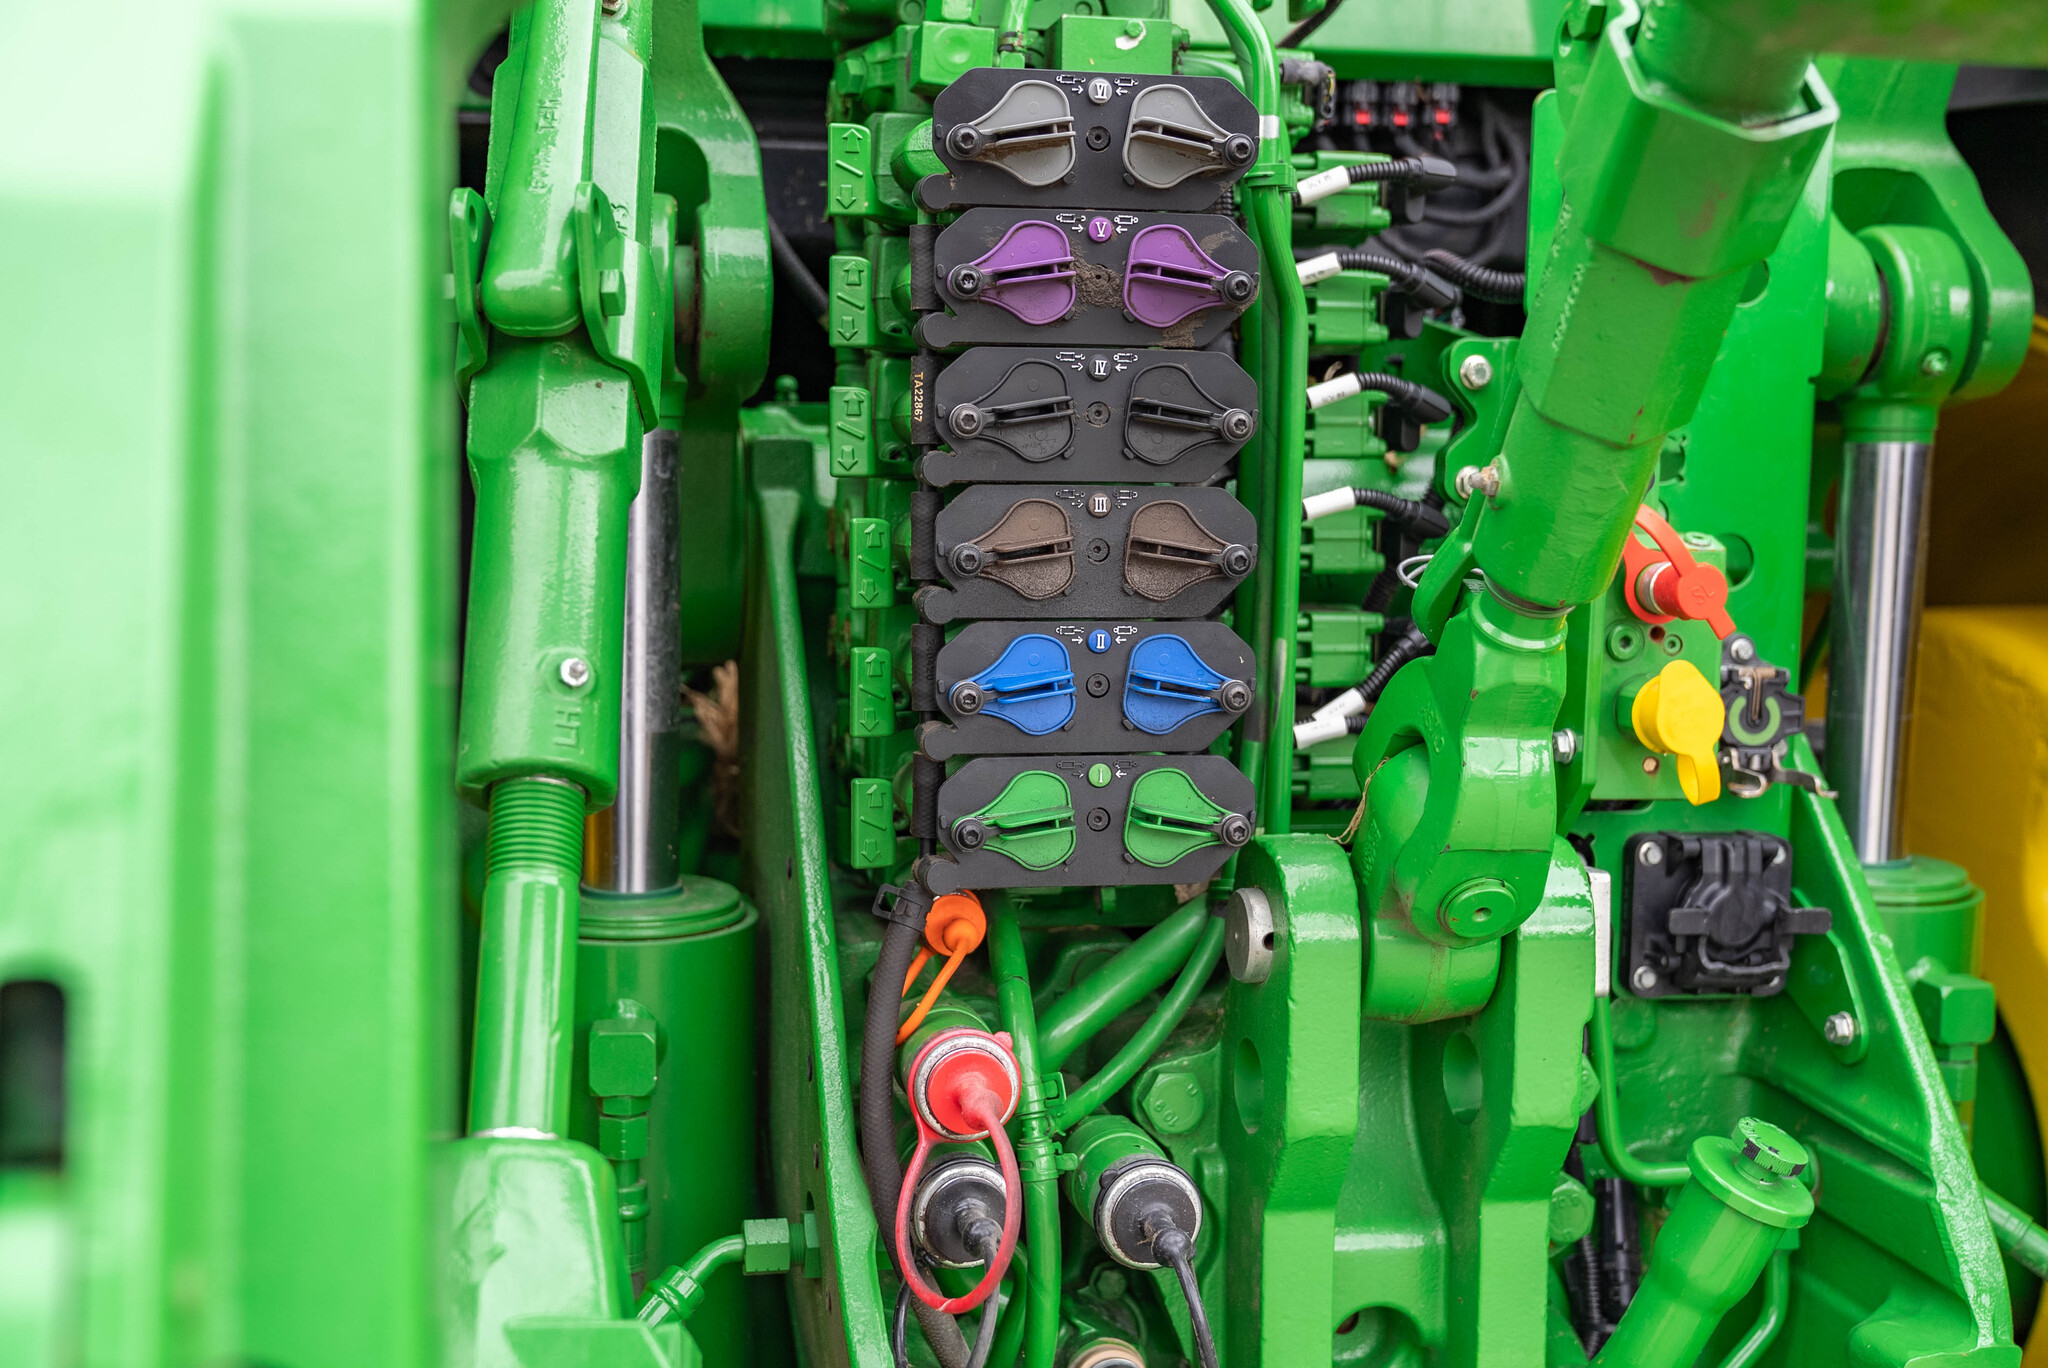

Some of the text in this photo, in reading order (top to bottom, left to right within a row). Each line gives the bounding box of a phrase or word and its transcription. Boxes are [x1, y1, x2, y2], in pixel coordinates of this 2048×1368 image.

[1094, 82, 1108, 99] VI
[1095, 221, 1107, 237] V
[1094, 359, 1107, 375] IV
[914, 371, 925, 423] TA22867
[1094, 496, 1108, 513] III
[1691, 579, 1716, 606] SL
[1095, 633, 1106, 650] II
[553, 706, 583, 749] LH
[1098, 768, 1104, 784] I
